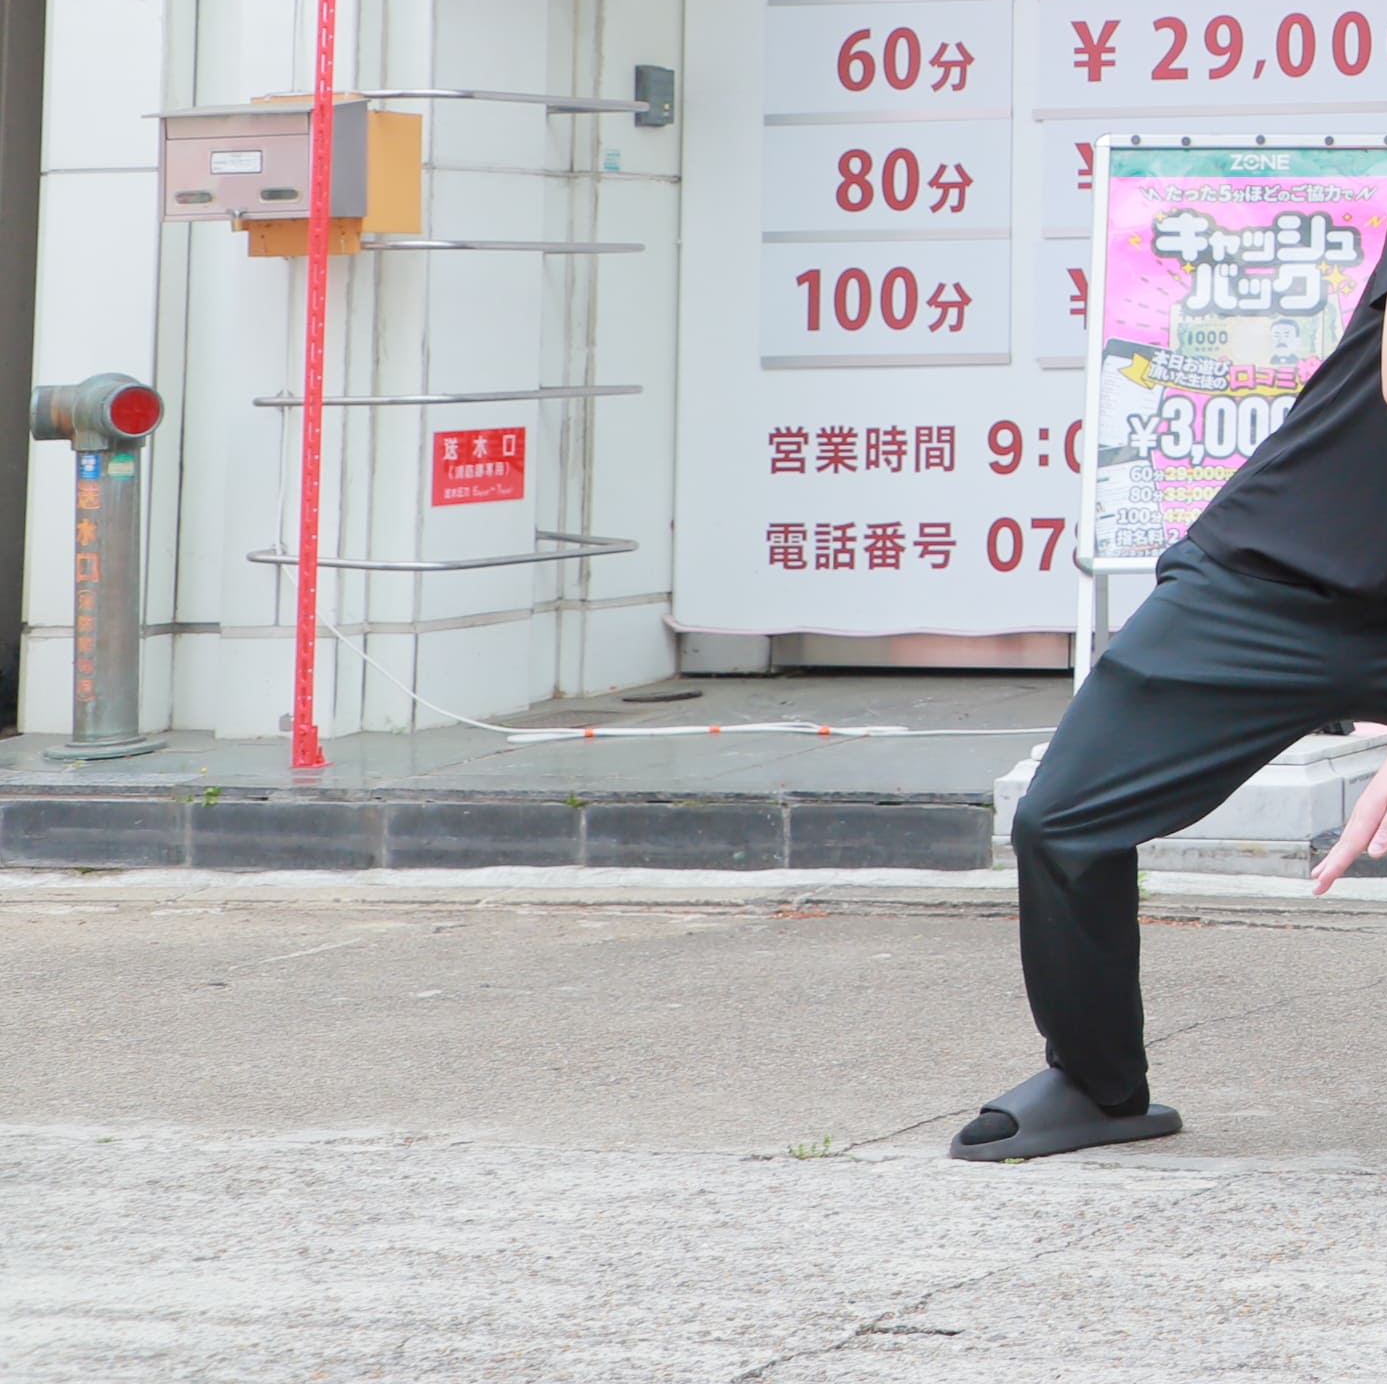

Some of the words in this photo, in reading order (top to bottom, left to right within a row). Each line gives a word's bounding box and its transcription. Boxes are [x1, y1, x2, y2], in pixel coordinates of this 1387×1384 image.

[836, 27, 975, 93] 60分
[835, 147, 974, 213] 80分
[1230, 154, 1291, 171] ZONE
[1154, 211, 1359, 262] キャッシュ
[796, 266, 973, 334] 100分
[1185, 262, 1326, 310] バック
[1187, 329, 1228, 345] 1000
[768, 425, 956, 474] 営業時間
[766, 521, 957, 570] 電話番号
